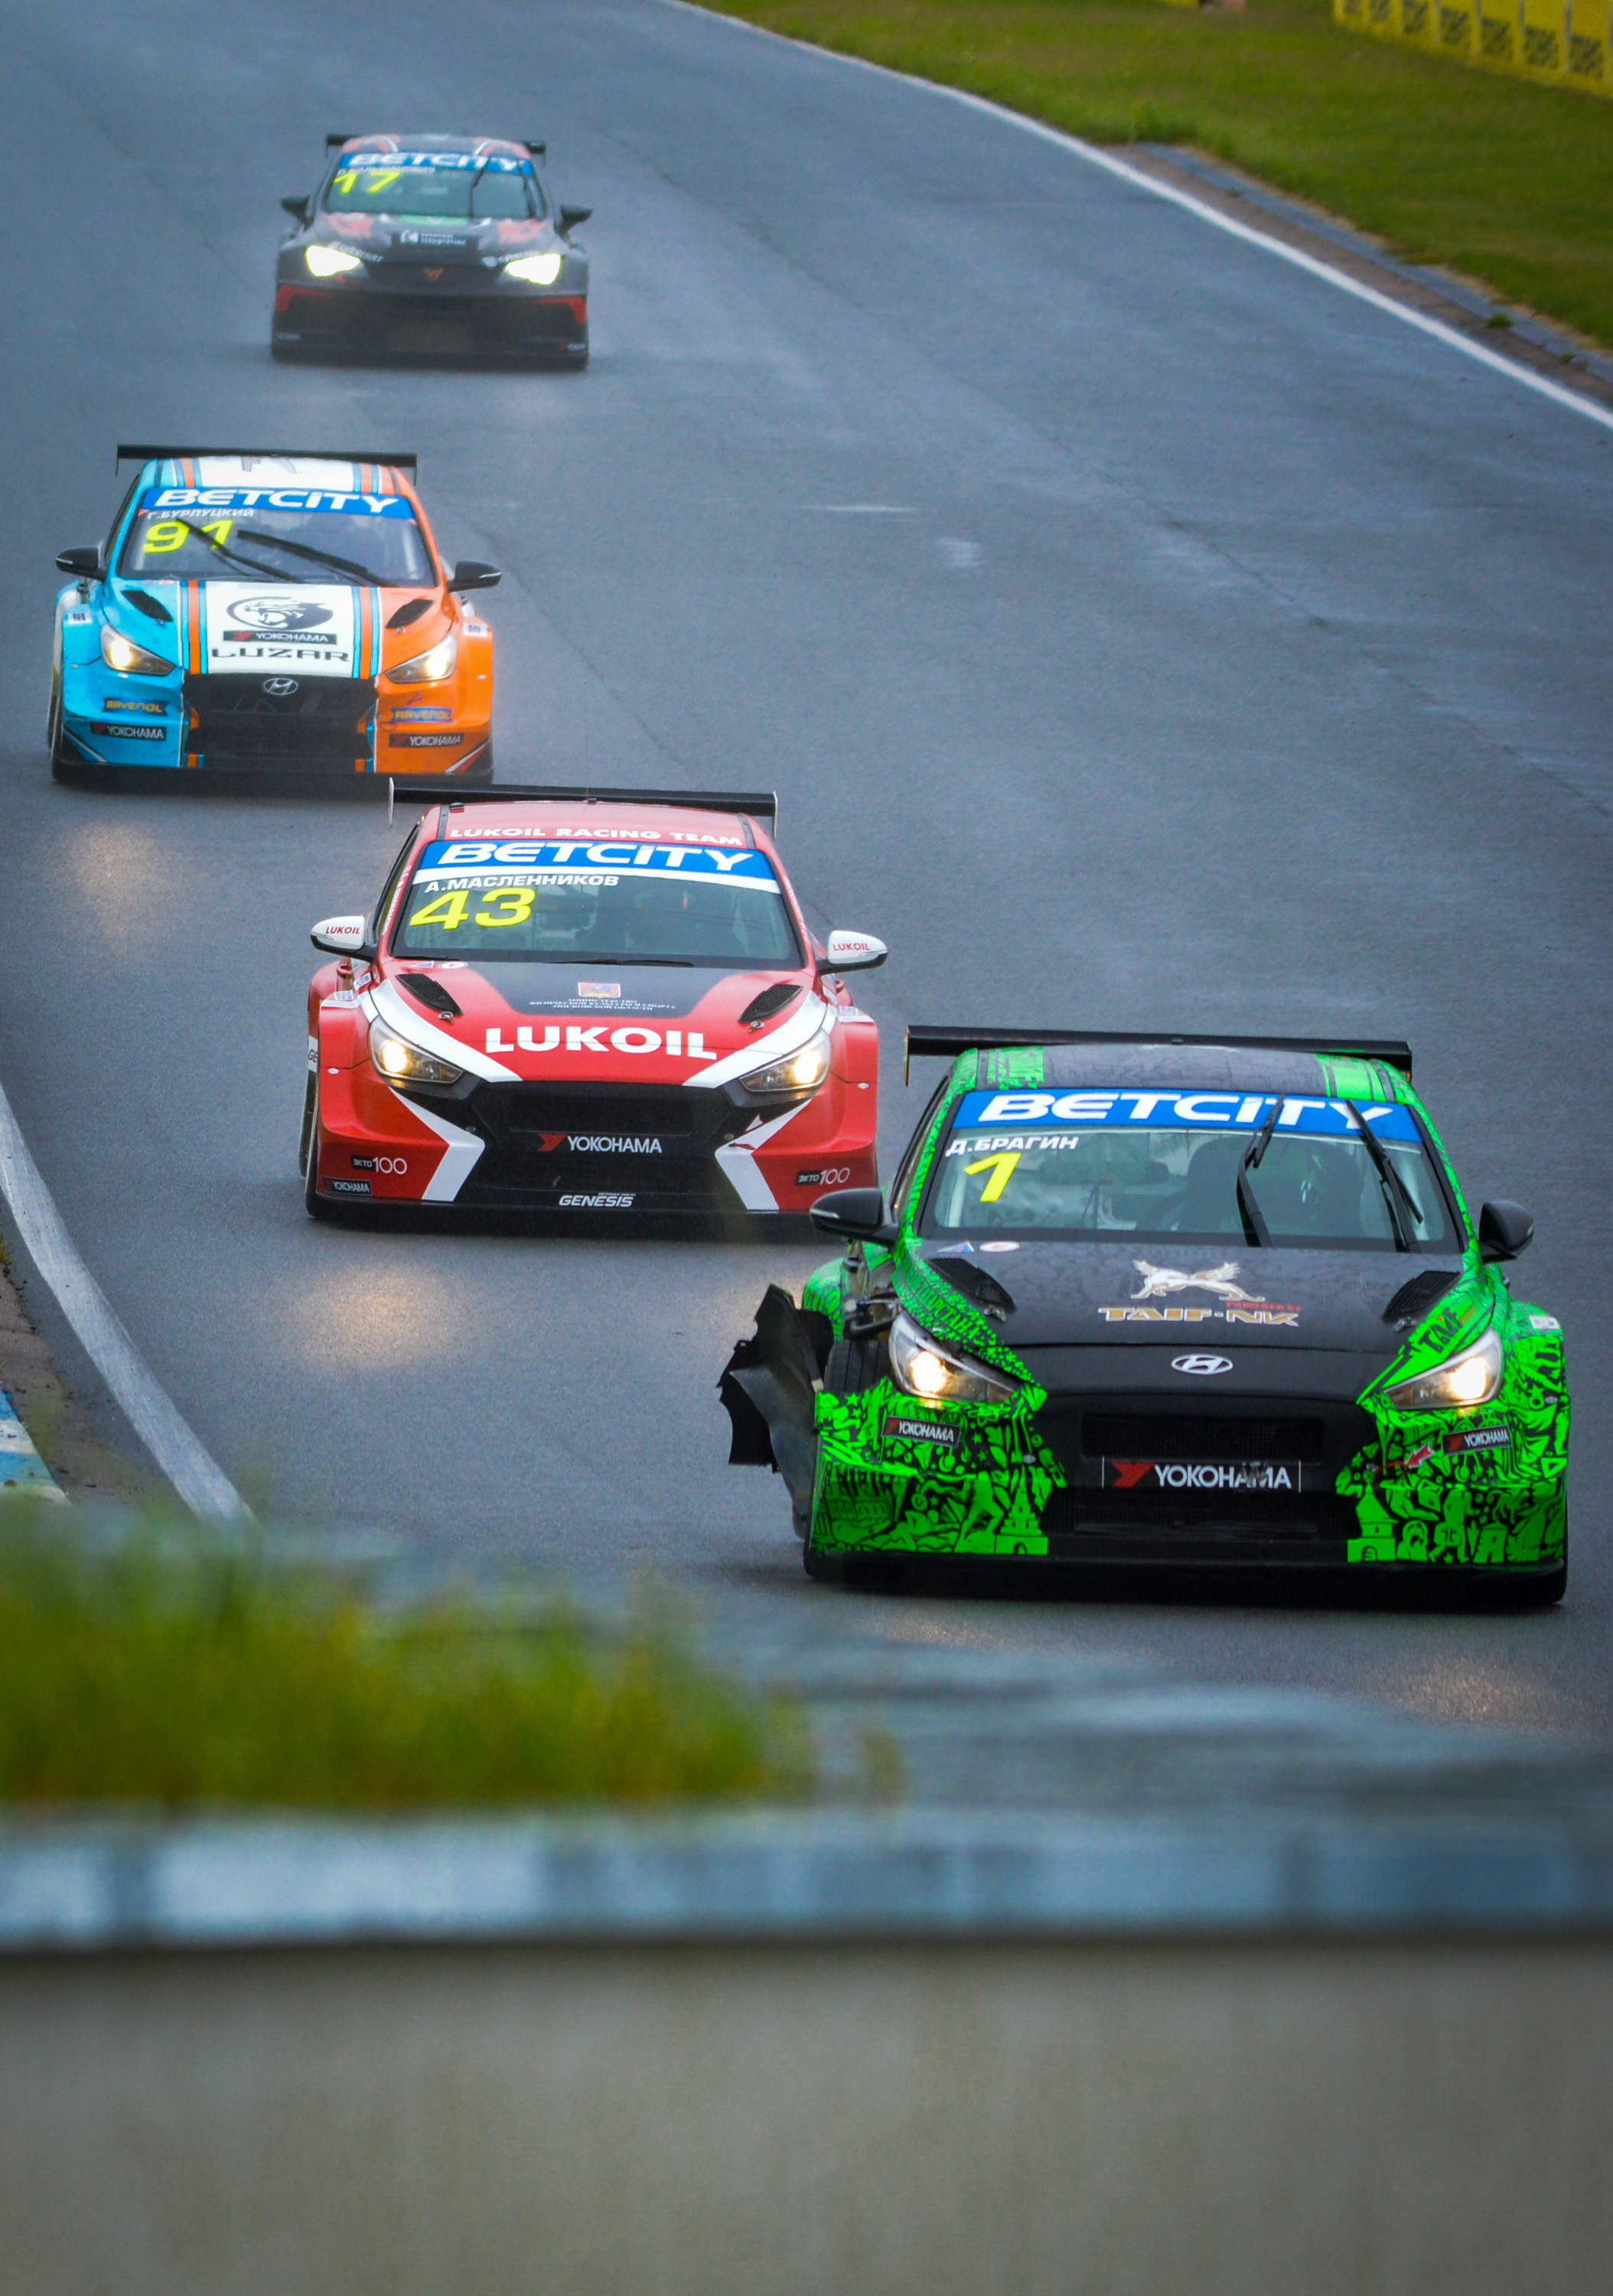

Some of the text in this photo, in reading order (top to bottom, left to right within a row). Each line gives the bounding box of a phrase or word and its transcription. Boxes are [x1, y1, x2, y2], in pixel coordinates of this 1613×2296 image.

[334, 171, 402, 194] 17
[155, 489, 400, 513] BETCITY
[148, 507, 254, 520] Г.БУРЛУЦКИЙ
[143, 519, 233, 553] 91
[256, 632, 329, 642] YOKOHAMA
[212, 647, 349, 662] LUZAR
[107, 726, 164, 739] YOKOHAMA
[410, 735, 461, 746] YOKOHAMA
[450, 828, 742, 846] LUKOIL RACING TEAM
[437, 842, 754, 871] BETCITY
[425, 876, 619, 893] А.МАСЛЕННИКОВ
[409, 887, 536, 930] 43
[833, 943, 870, 951] LUKOIL
[486, 1026, 717, 1060] LUKOIL
[978, 1092, 1393, 1129] BETCITY
[567, 1136, 663, 1153] YOKOHAMA
[946, 1137, 1078, 1155] Д.БРАГИН
[332, 1181, 370, 1192] YOKOHAMA
[964, 1153, 1021, 1202] 1
[559, 1195, 634, 1207] GENESIS
[1098, 1306, 1299, 1326] TAIF-NK
[899, 1420, 954, 1442] YOKOHAMA
[1464, 1429, 1510, 1447] YOKOHAMA
[1155, 1464, 1292, 1489] YOKOHAMA
